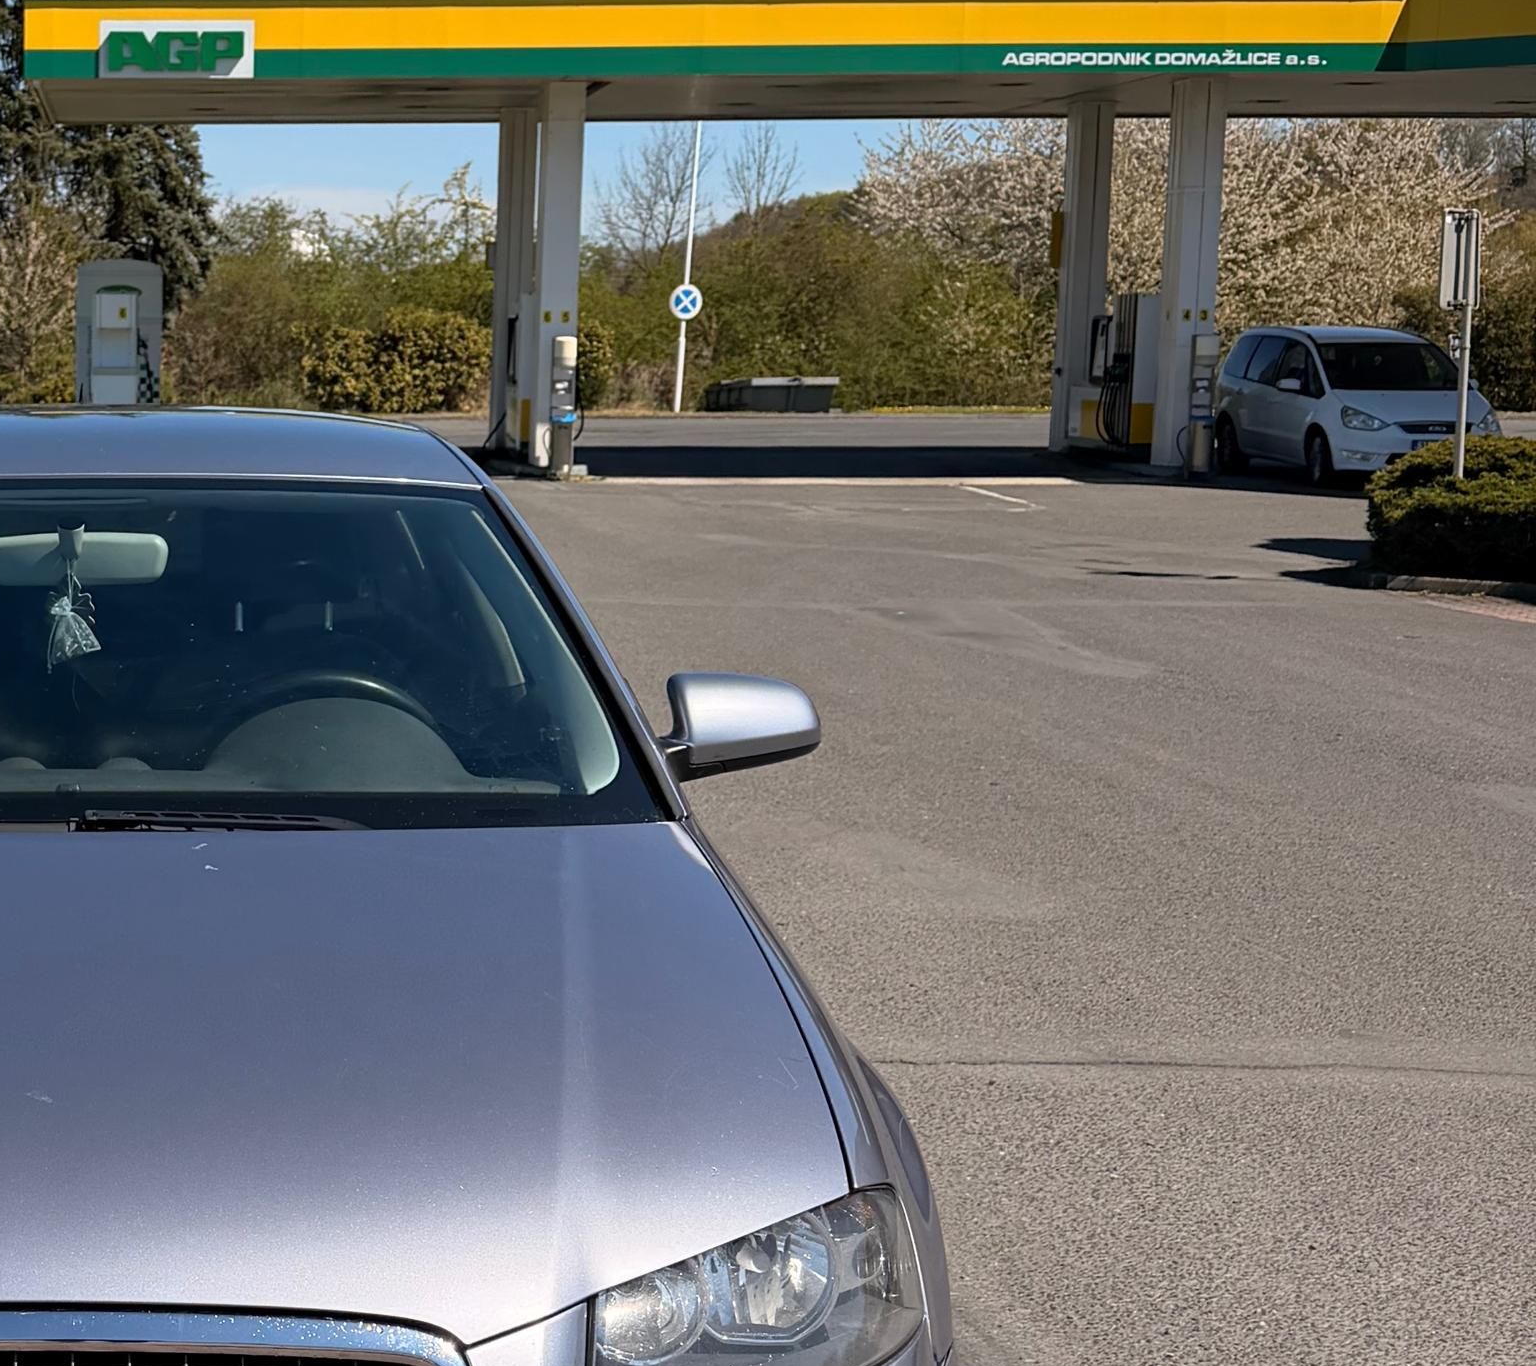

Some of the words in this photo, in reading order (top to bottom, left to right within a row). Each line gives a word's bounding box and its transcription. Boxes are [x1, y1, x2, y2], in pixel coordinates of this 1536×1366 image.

[108, 31, 245, 71] AGP
[1001, 51, 1151, 66] AGROPODNIK
[1154, 49, 1281, 66] DOMAŽLICE
[1284, 52, 1328, 66] a.s.
